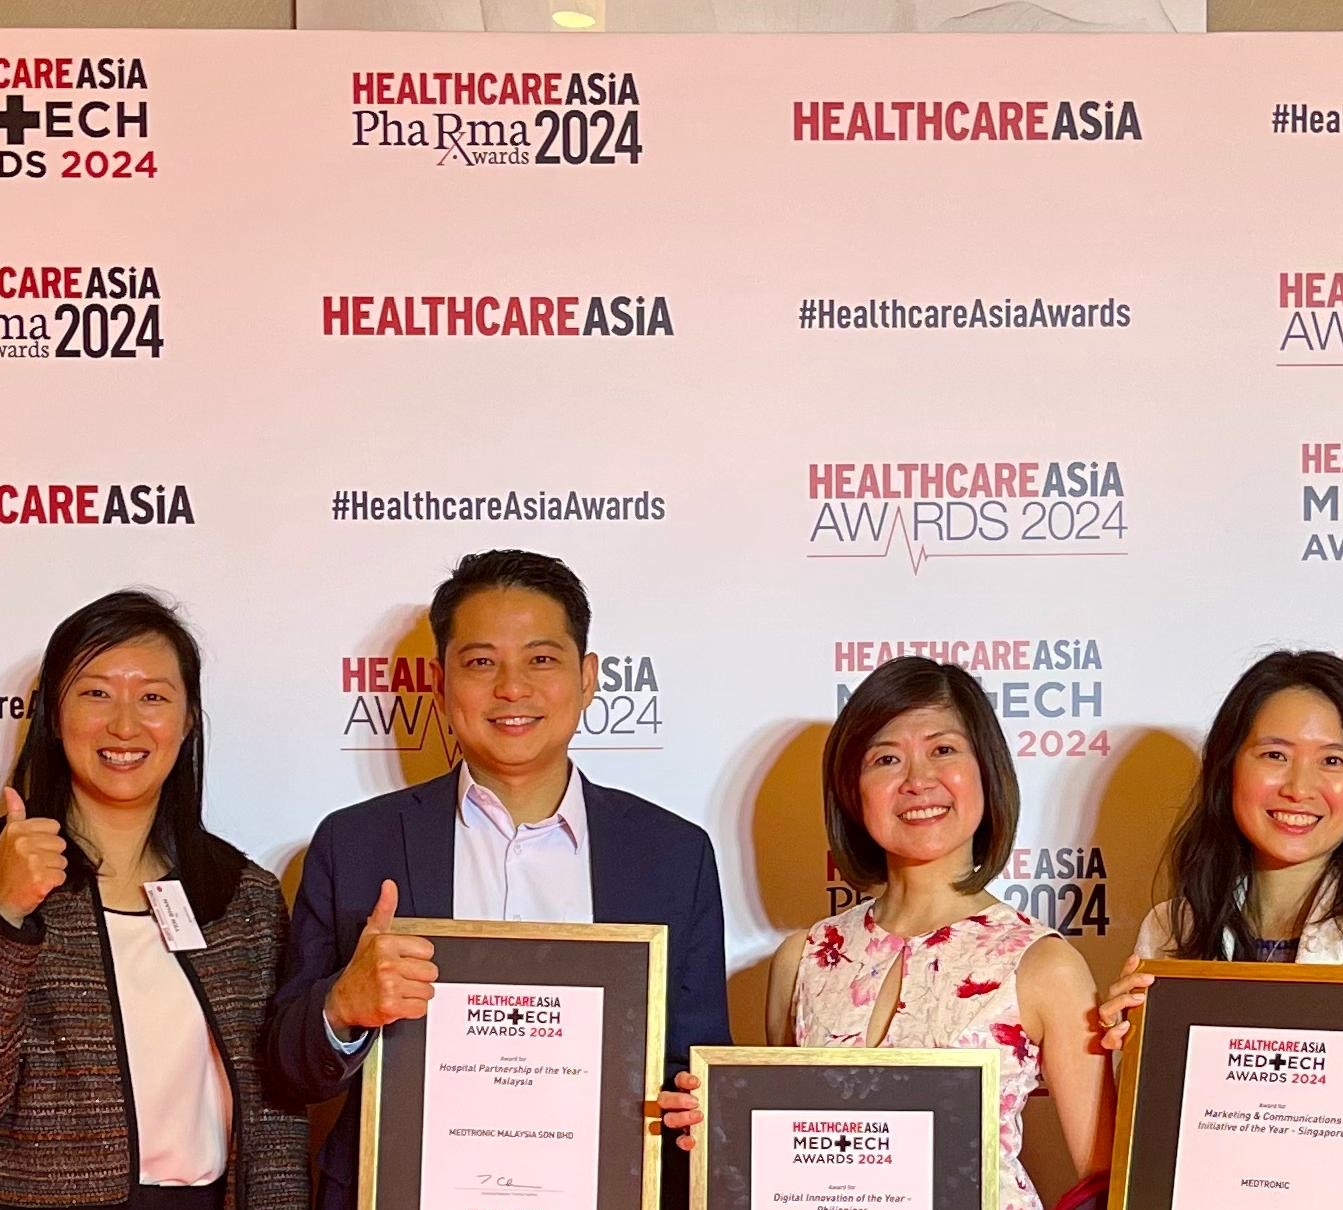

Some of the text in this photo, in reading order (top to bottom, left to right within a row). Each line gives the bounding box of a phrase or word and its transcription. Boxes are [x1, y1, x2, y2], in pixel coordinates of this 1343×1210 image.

[793, 101, 1142, 141] HEALTHCAREASiA
[535, 110, 642, 165] 2024
[61, 151, 157, 178] 2024
[323, 296, 674, 336] HEALTHCAREASiA
[799, 298, 1130, 328] #HealthcareAsiaAwards
[55, 304, 164, 358] 2024
[332, 491, 665, 520] #HealthcareAsiaAwards
[1021, 501, 1128, 541] 2024
[1017, 730, 1110, 757] 2024
[466, 1026, 563, 1037] AWARDS 2024
[439, 1064, 476, 1072] Hospital
[479, 1064, 532, 1075] Partnership
[534, 1066, 543, 1074] of
[494, 1076, 533, 1086] Malaysia
[1226, 1071, 1326, 1084] AWARDS 2024
[1205, 1110, 1341, 1124] Marketing & Communications
[449, 1129, 496, 1137] MEDTRONIC
[497, 1130, 536, 1138] MALAYSIA
[1198, 1121, 1237, 1131] Initiative
[1240, 1124, 1249, 1132] of
[1251, 1124, 1266, 1132] the
[1269, 1125, 1289, 1134] Year
[793, 1154, 892, 1164] AWARDS 2024
[1241, 1179, 1290, 1189] MEDTRONIC
[774, 1193, 803, 1203] Digital
[806, 1193, 854, 1202] Innovation
[856, 1194, 866, 1202] of
[868, 1194, 882, 1202] the
